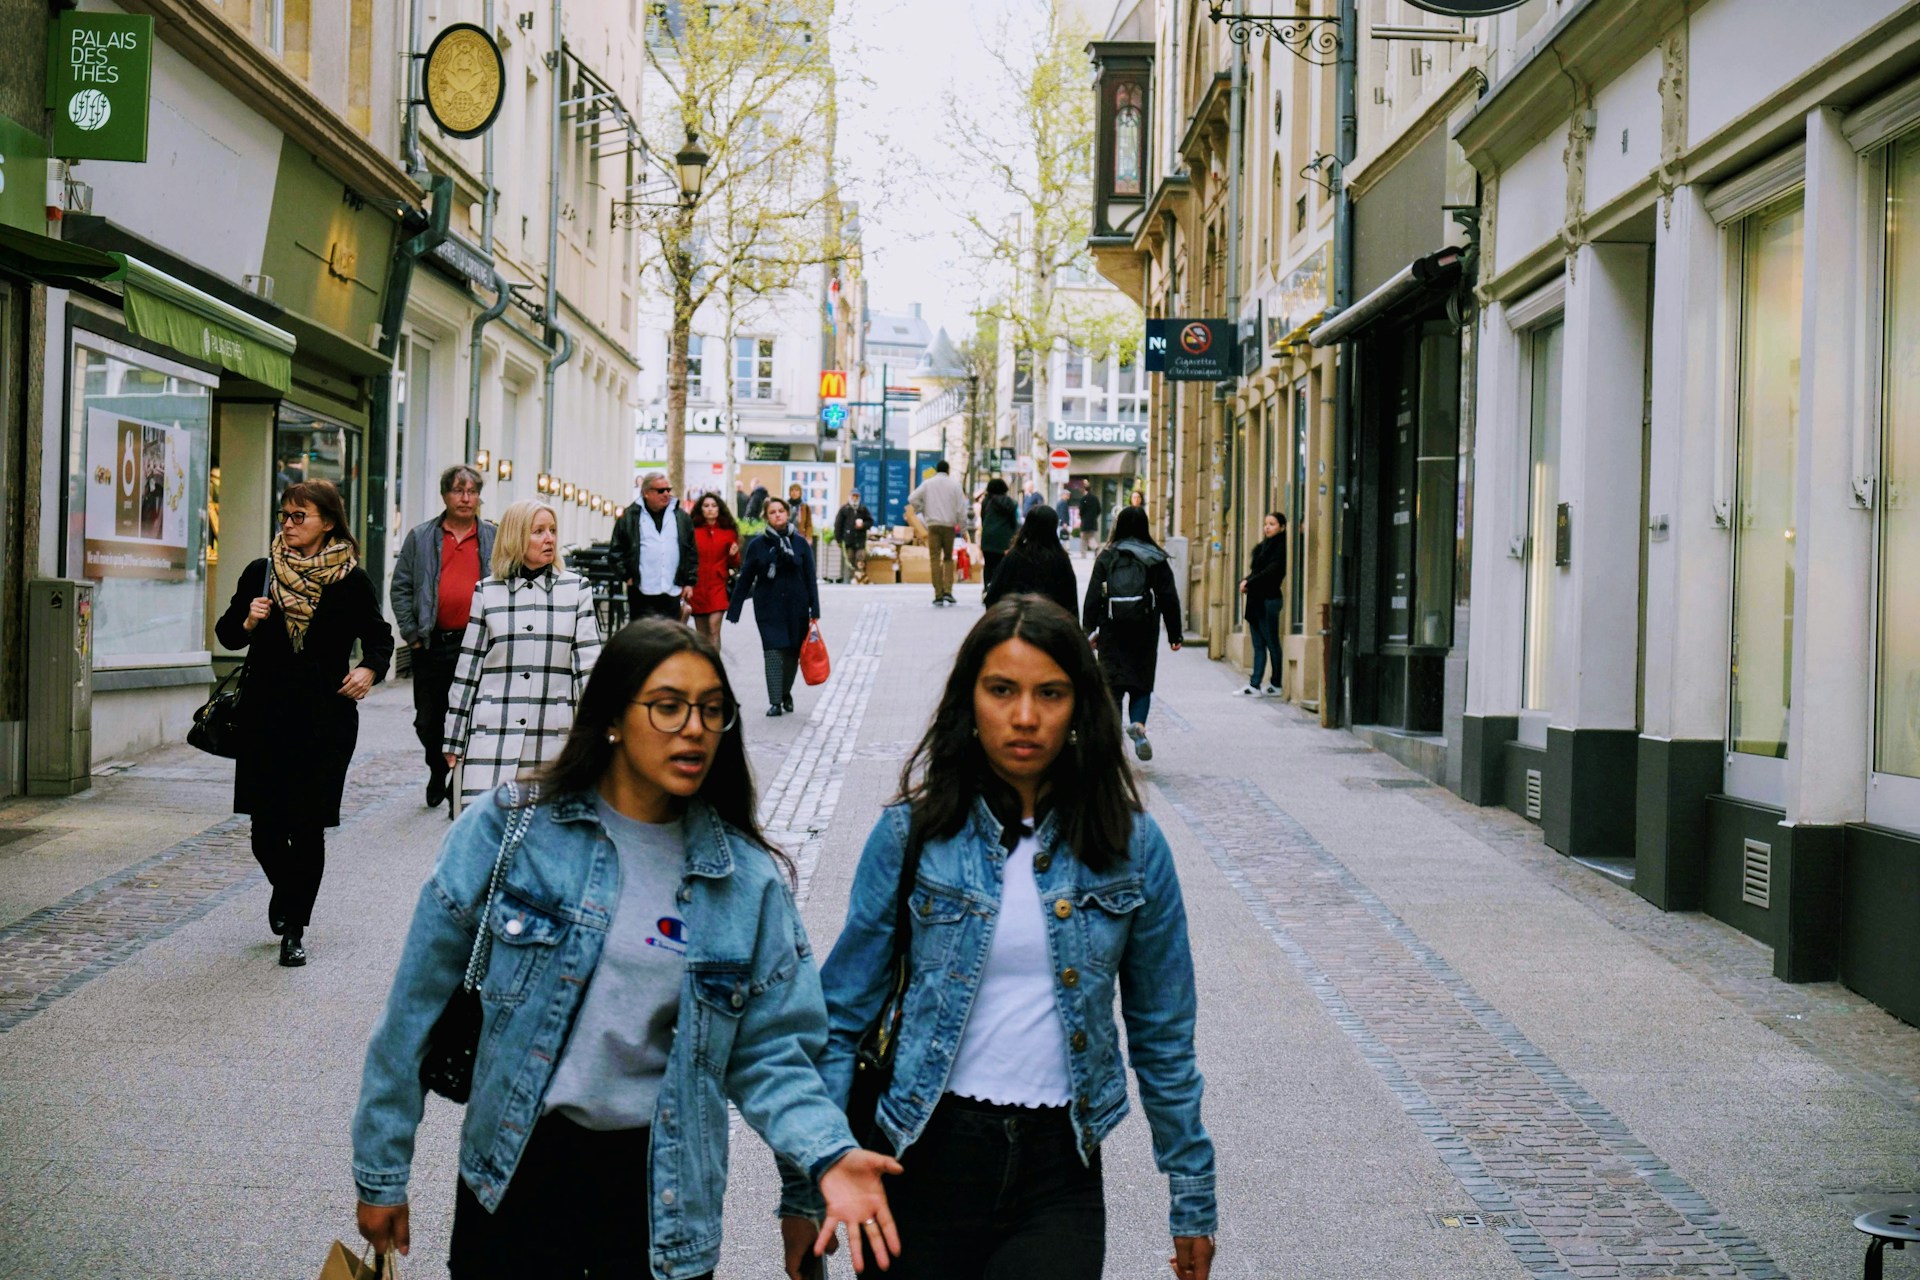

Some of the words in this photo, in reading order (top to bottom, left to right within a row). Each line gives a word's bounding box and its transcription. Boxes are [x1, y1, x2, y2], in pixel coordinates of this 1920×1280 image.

[72, 29, 137, 50] PALAIS
[71, 46, 108, 65] DES
[1053, 421, 1137, 443] Brasserie
